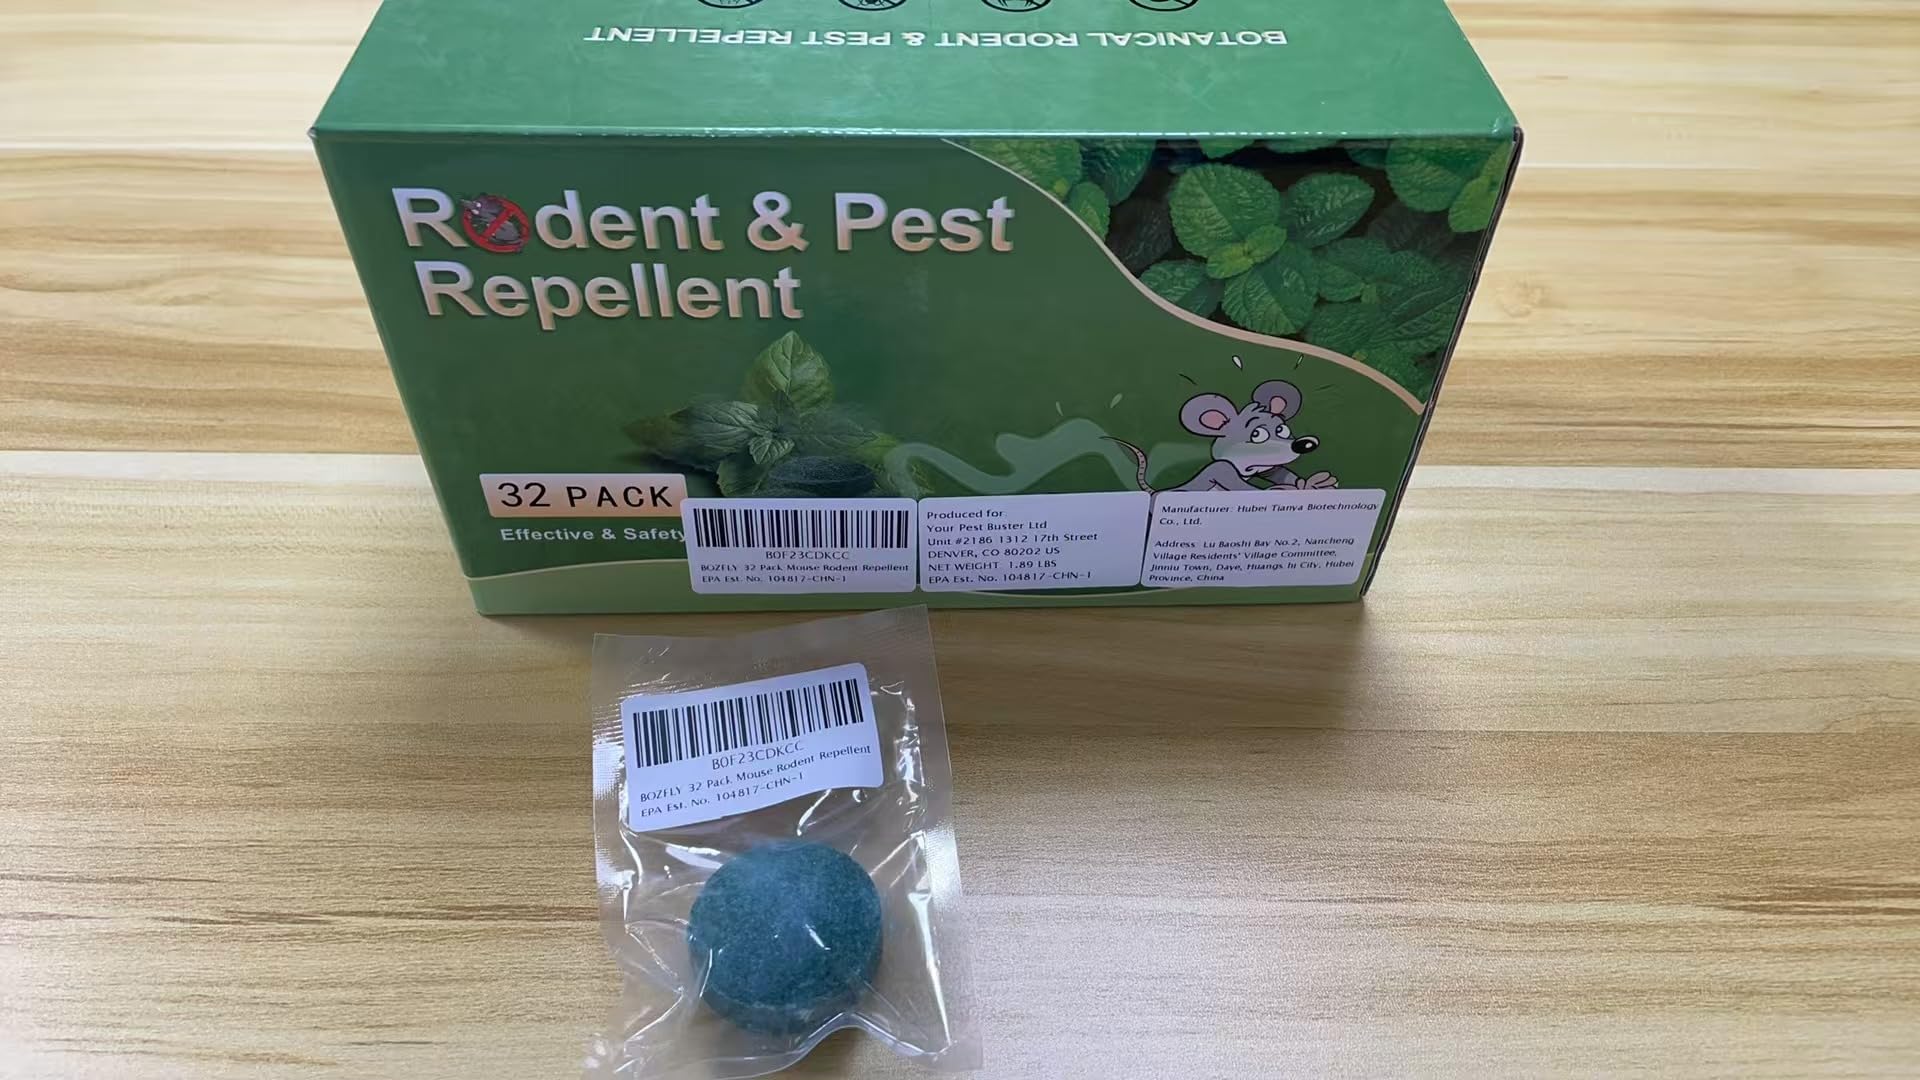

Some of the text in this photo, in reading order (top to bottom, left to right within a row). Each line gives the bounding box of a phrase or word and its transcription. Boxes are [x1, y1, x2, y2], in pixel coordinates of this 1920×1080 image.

[583, 27, 1288, 47] BOTANICAL RODENT & PEST REPELLENT
[391, 187, 1015, 254] Rodent & Pest
[413, 260, 804, 331] Repellent
[498, 482, 673, 507] 32 PACK
[1238, 504, 1268, 512] Hubei
[1307, 502, 1378, 511] Biotechnology
[927, 509, 1004, 519] Produced for
[927, 521, 1048, 532] Your Pest Buster Ltd
[1160, 517, 1203, 526] Co., Ltd.
[501, 528, 686, 542] Effective & Safety
[928, 533, 1098, 546] Unit #2186 1312 17th Street
[1218, 540, 1251, 548] Baoshi
[928, 550, 978, 559] DENVER,
[982, 549, 1000, 557] CO
[1004, 548, 1040, 556] 80202
[1153, 552, 1187, 561] Village
[1244, 550, 1277, 560] Village
[1280, 549, 1337, 558] Committee,
[862, 564, 909, 573] Repellent
[928, 560, 1056, 571] NET WEIGHT 1.89 LBS
[1184, 564, 1212, 572] Town,
[1216, 563, 1243, 572] Daye,
[1325, 560, 1354, 568] Hubei
[929, 571, 1091, 584] EPA Est. No. 104817-CHN-1
[1149, 573, 1225, 582] Province, China
[640, 744, 871, 803] BOZFLY 32 Pack Mouse Rodent Repellent
[641, 773, 803, 817] EPA Est. No. 104817-CHN-1
